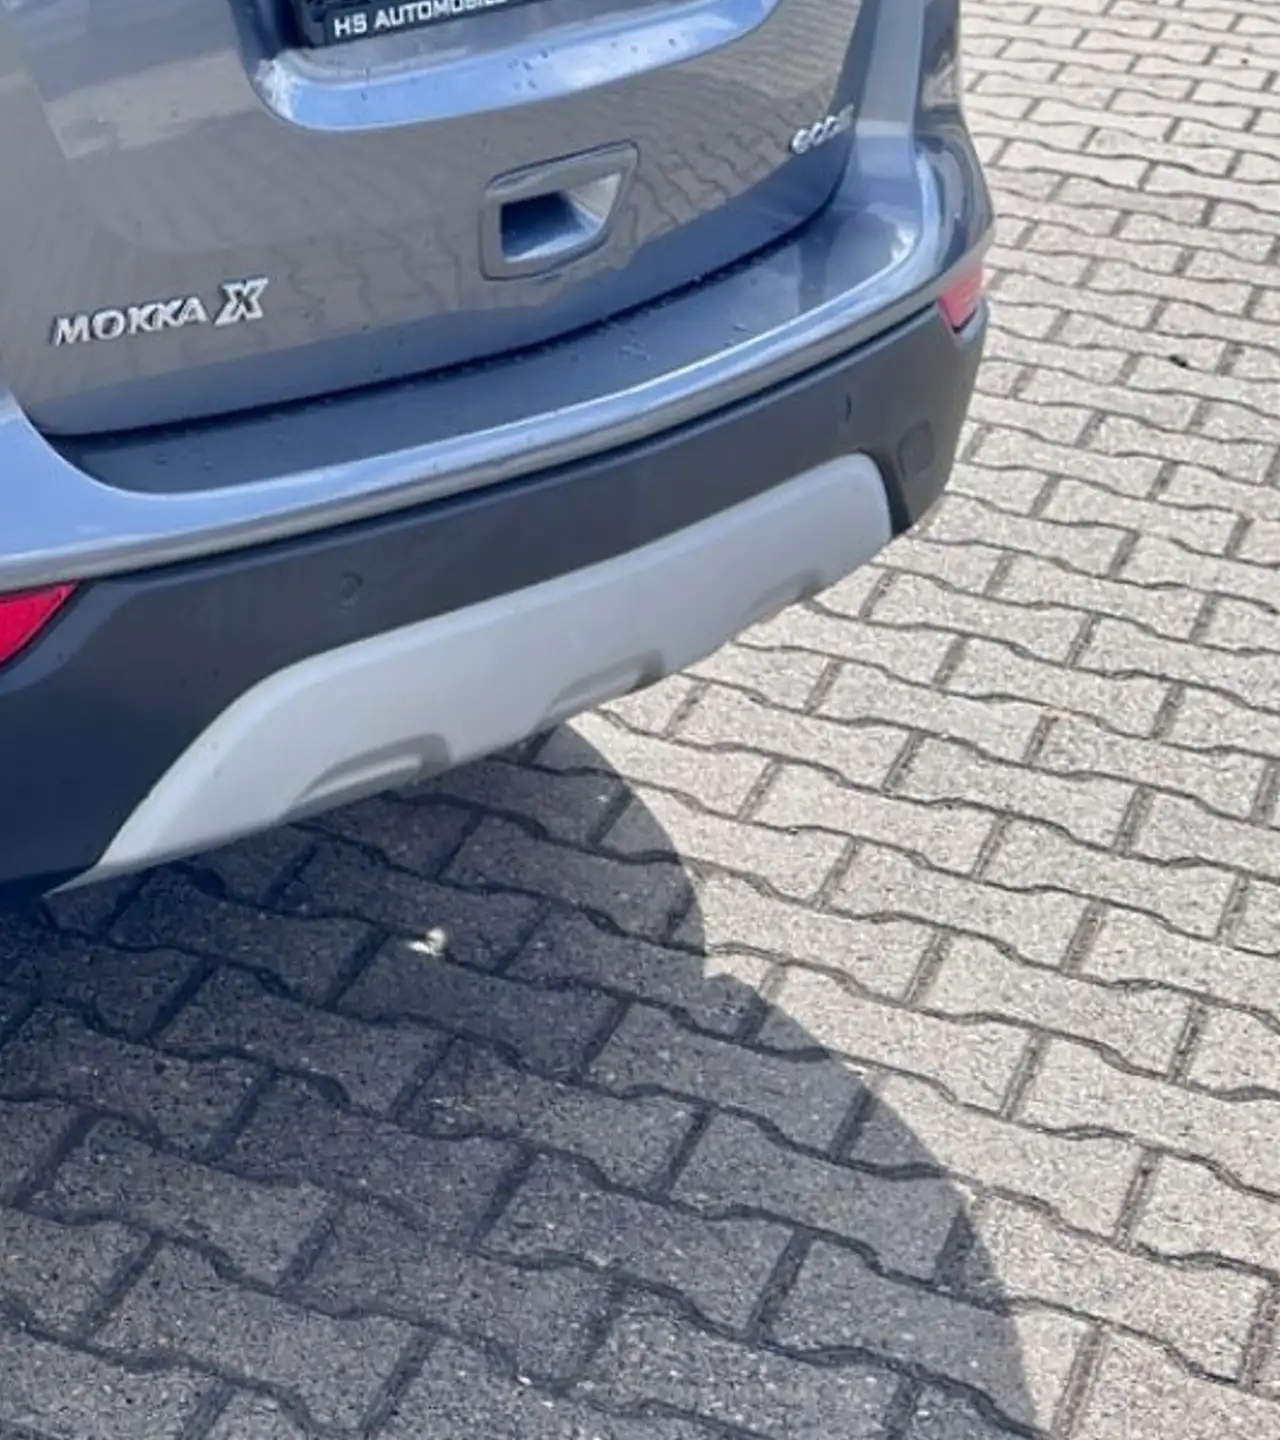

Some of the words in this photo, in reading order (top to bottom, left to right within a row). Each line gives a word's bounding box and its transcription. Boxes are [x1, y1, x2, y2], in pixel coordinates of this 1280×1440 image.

[333, 13, 368, 38] HS
[54, 296, 208, 346] MOKKA
[213, 276, 269, 326] X
